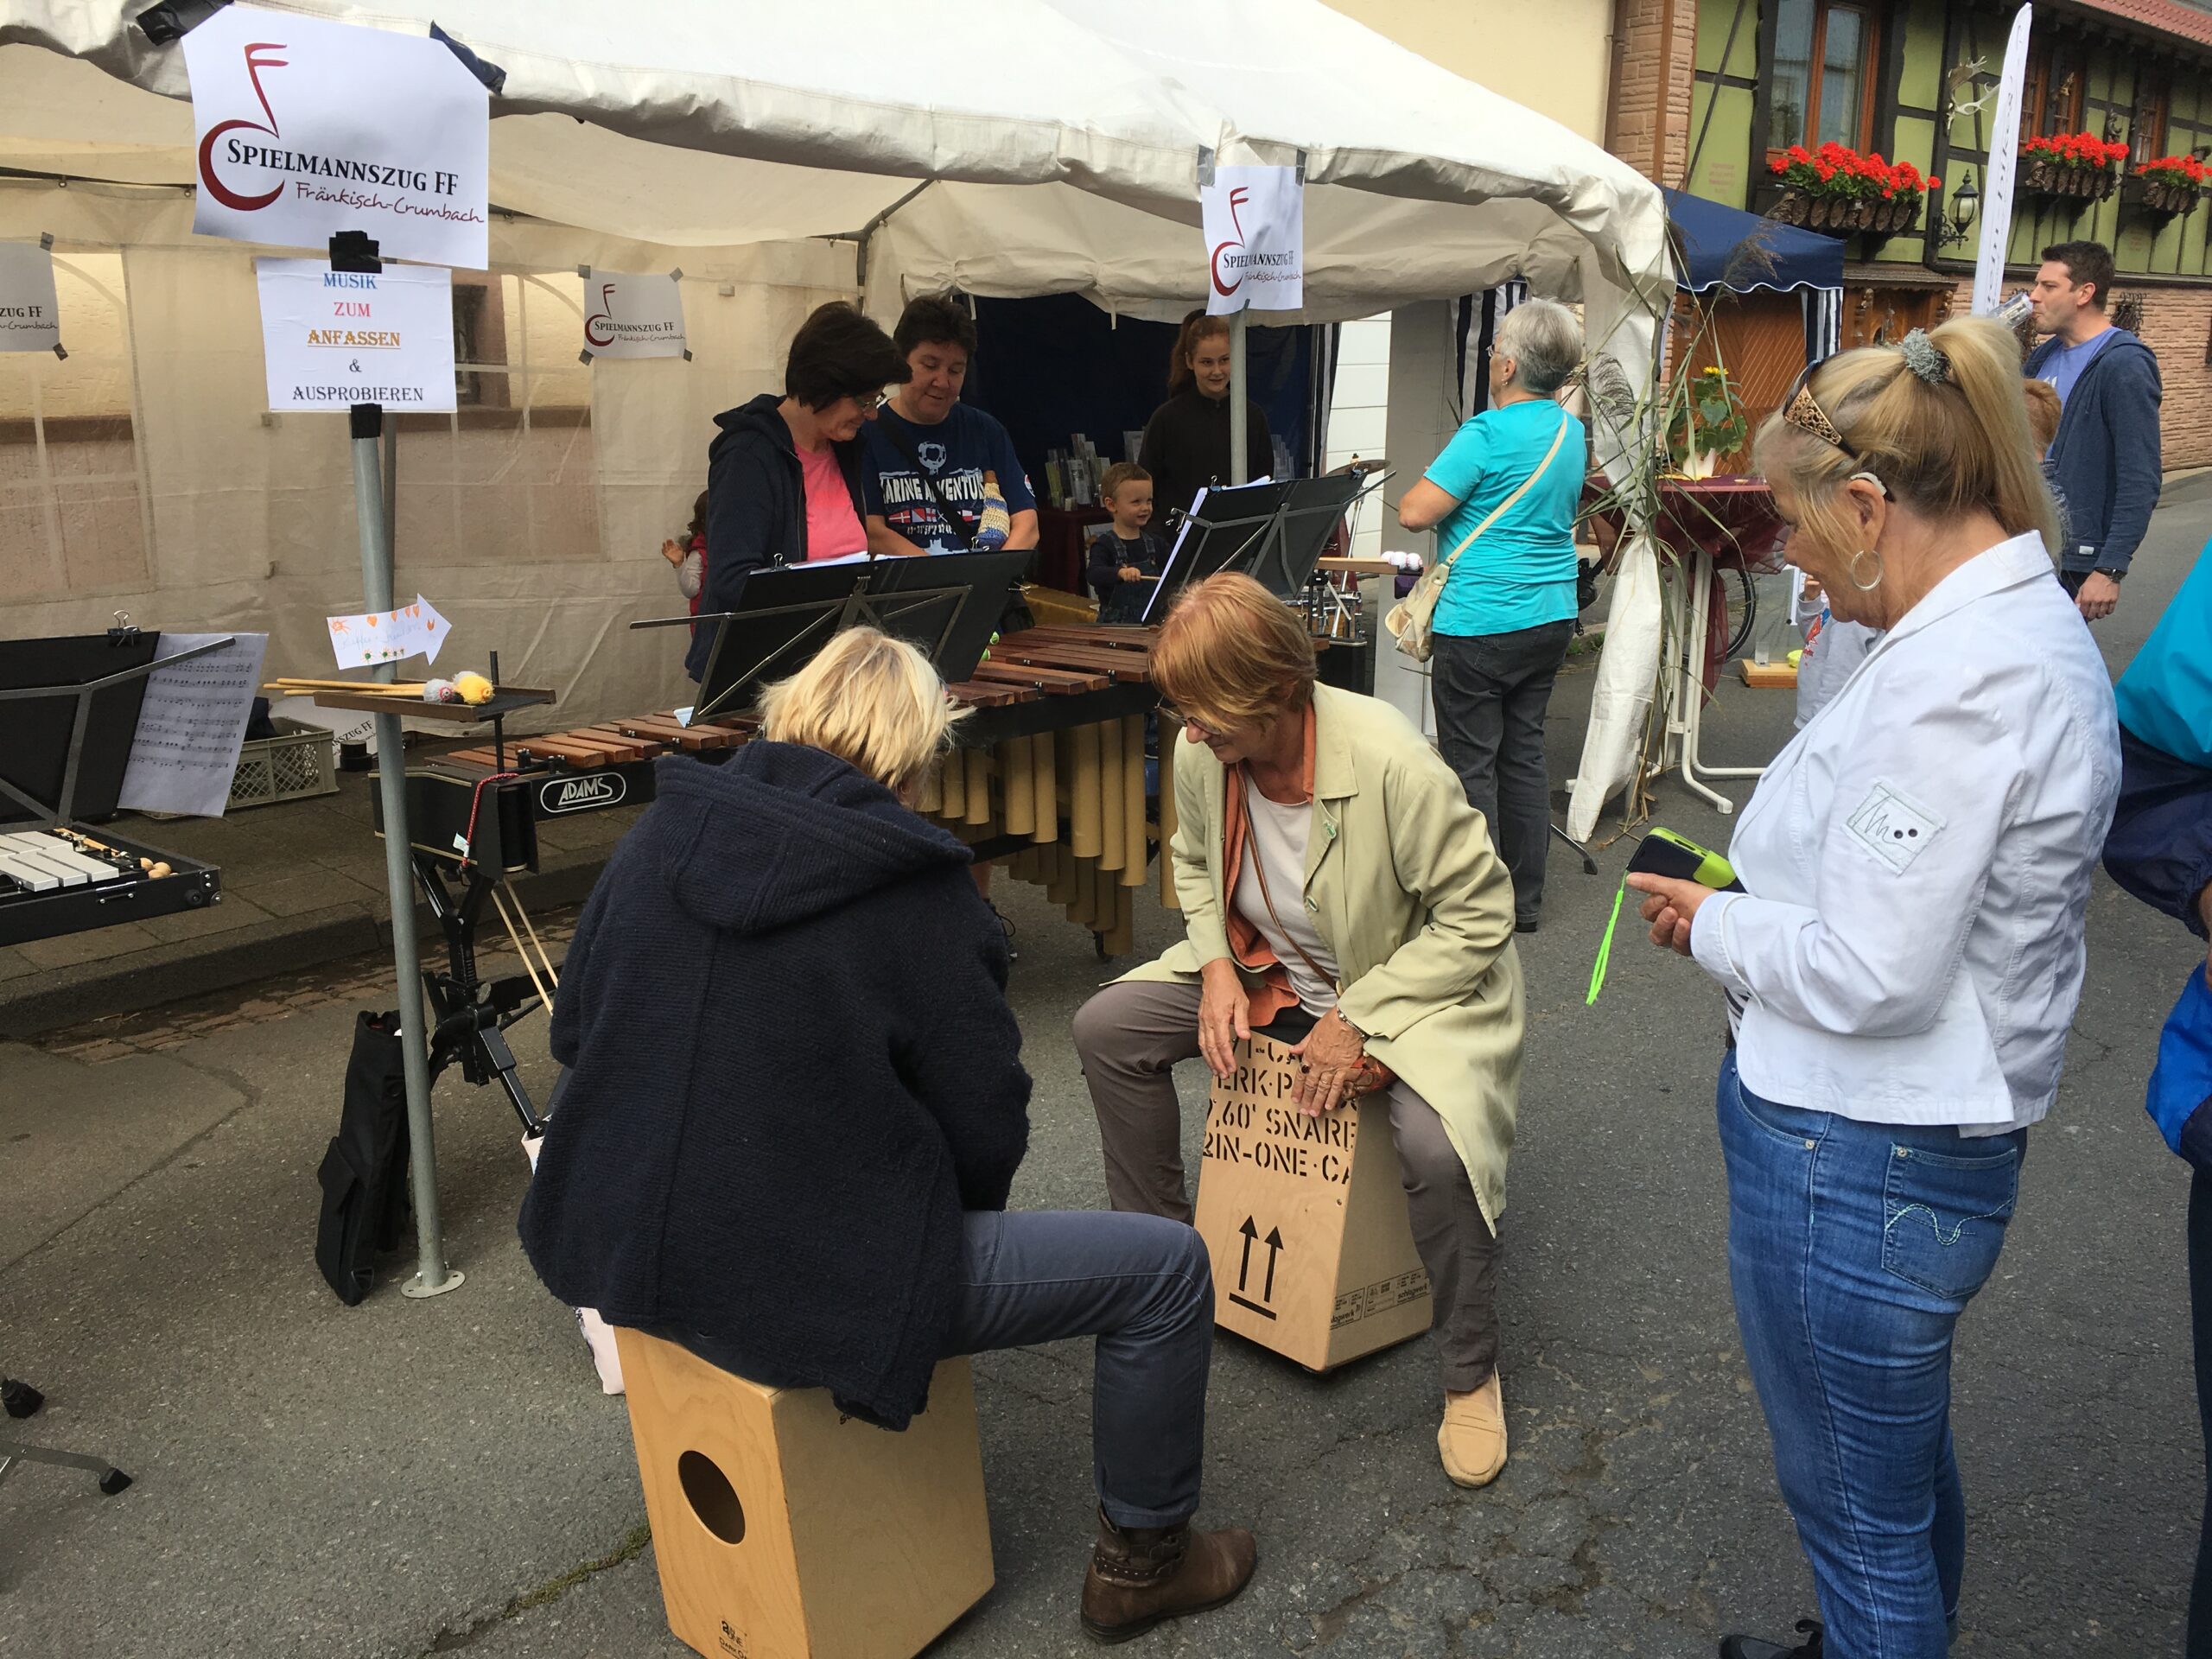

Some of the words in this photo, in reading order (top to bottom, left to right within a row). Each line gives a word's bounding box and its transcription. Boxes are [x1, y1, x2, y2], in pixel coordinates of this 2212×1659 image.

[435, 171, 459, 196] FF
[296, 181, 484, 224] Fränkisch-Crumbach
[323, 272, 378, 289] MUSIK
[28, 306, 42, 318] FF
[334, 302, 372, 318] ZUM
[664, 321, 675, 331] FF
[307, 329, 401, 347] ANFASSEN
[349, 359, 362, 373] &
[293, 385, 423, 403] AUSPROBIEREN
[557, 777, 613, 806] ADAMS
[1266, 1108, 1357, 1153] SNARE
